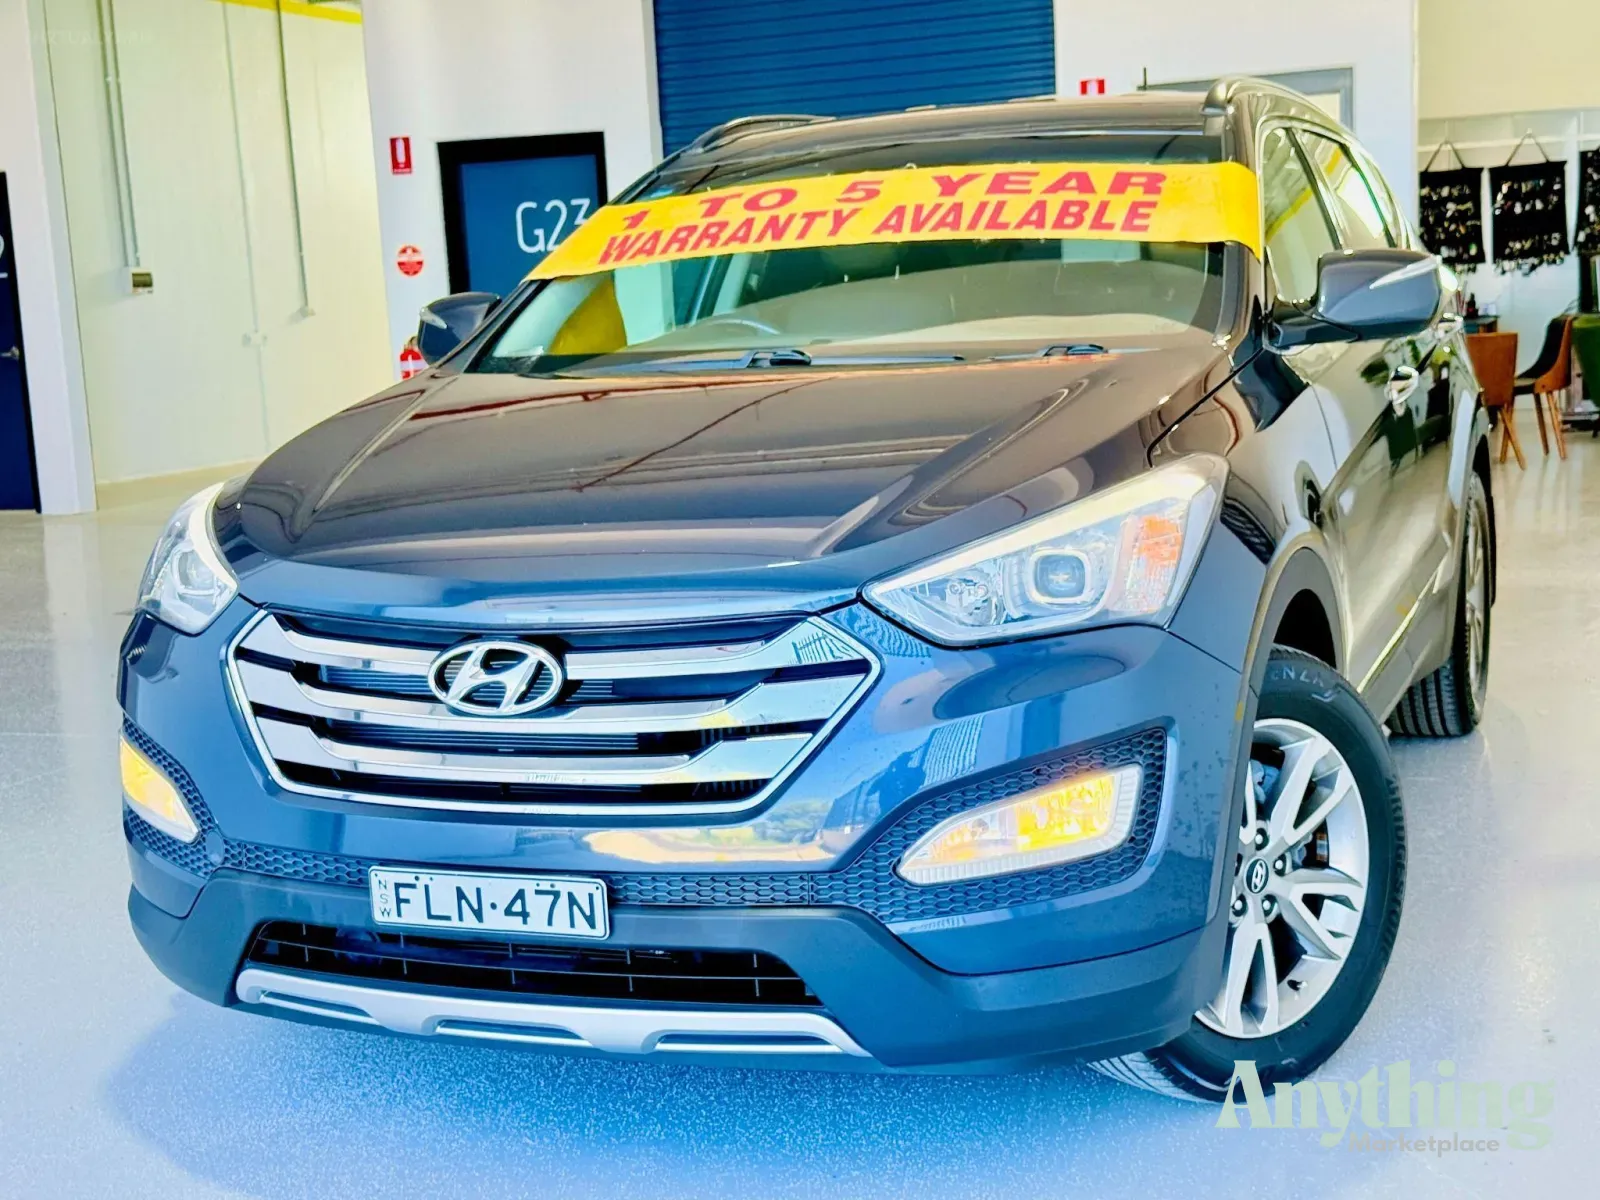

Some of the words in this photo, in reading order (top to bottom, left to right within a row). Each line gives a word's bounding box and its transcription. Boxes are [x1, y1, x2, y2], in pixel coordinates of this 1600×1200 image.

[622, 210, 650, 230] 1
[700, 188, 797, 218] TO
[836, 180, 884, 203] 5
[931, 171, 1167, 197] YEAR
[598, 208, 862, 265] WARRANTY
[871, 200, 1158, 235] AVAILABLE
